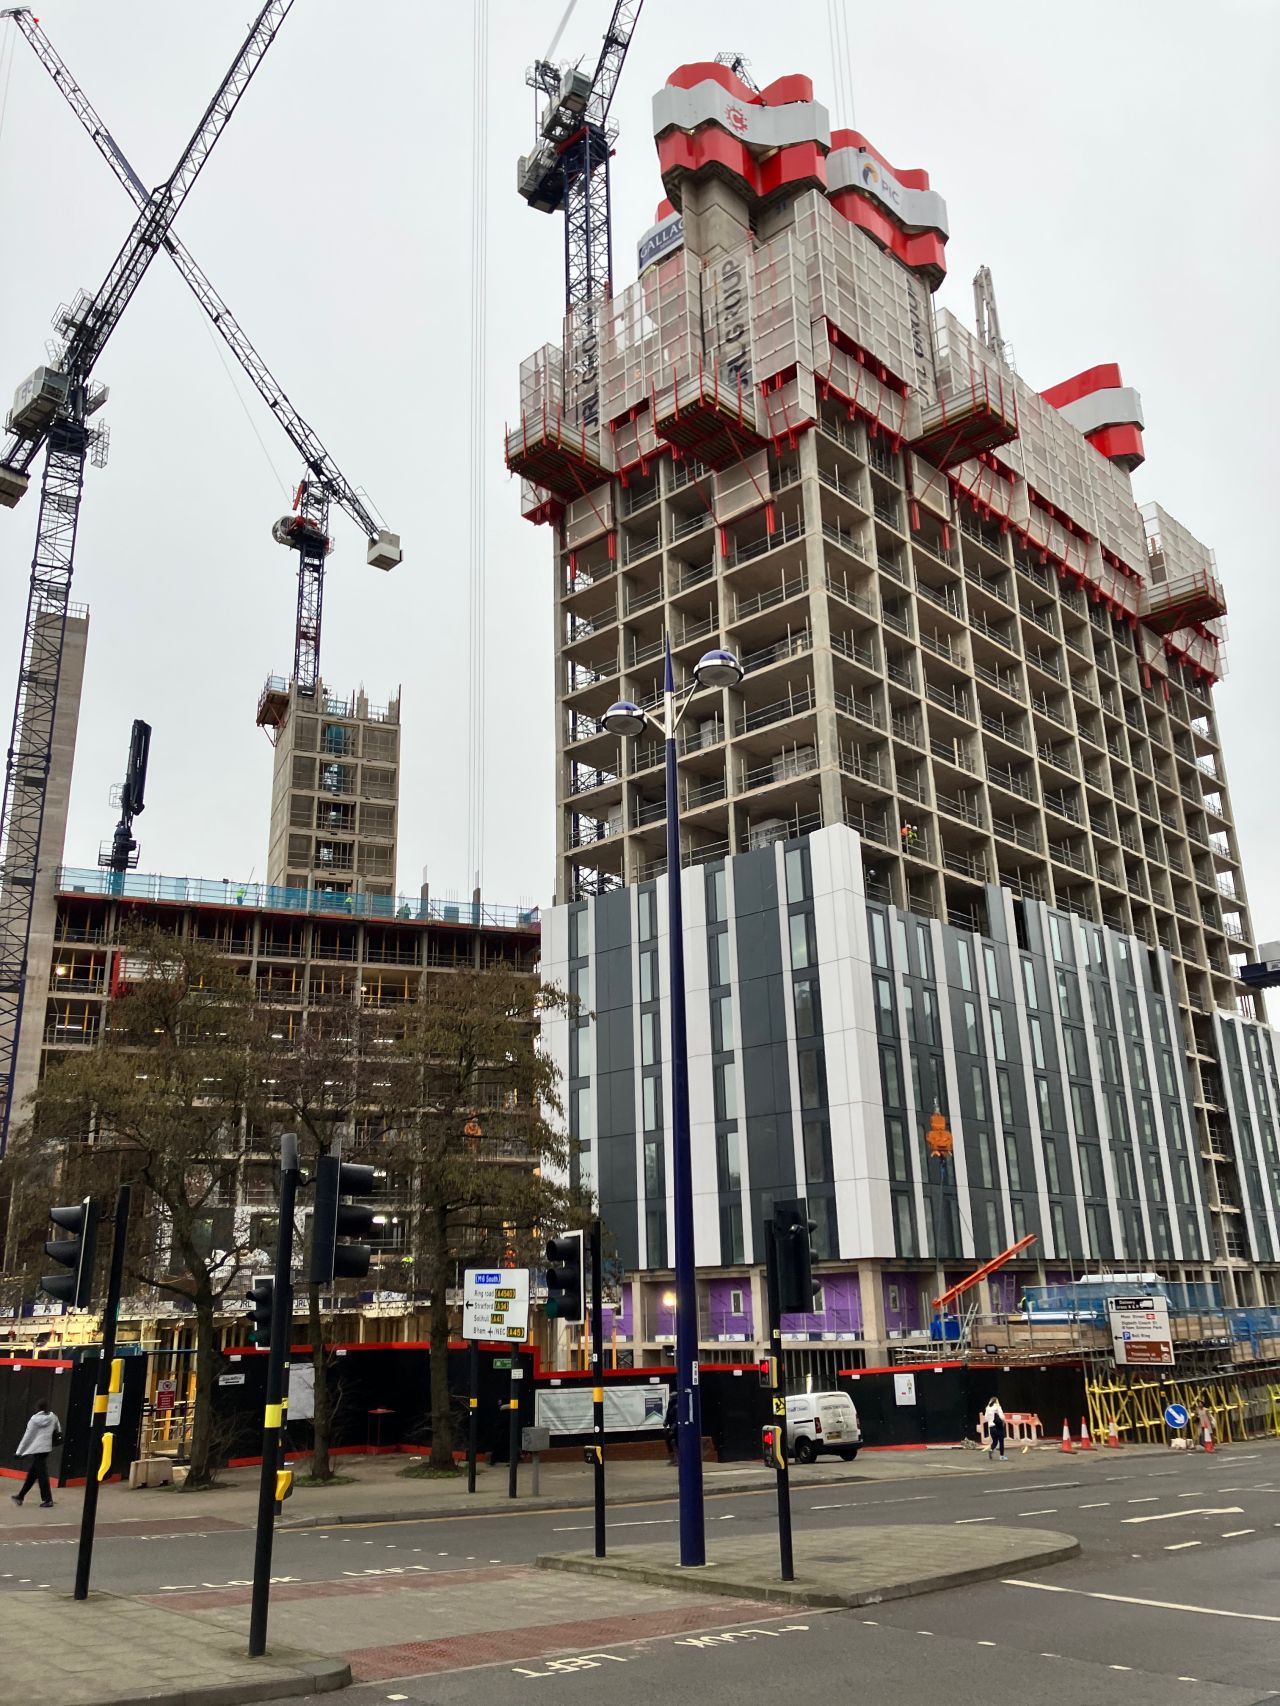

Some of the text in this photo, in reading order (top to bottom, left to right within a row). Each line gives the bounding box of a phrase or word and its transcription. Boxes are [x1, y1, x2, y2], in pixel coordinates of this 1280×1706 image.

[881, 179, 900, 205] PIC
[721, 259, 745, 344] GROUP
[582, 384, 600, 428] JRL
[474, 1302, 494, 1310] Stratford
[342, 1565, 430, 1576] LEFT
[511, 1628, 780, 1678] LOOK LEFT
